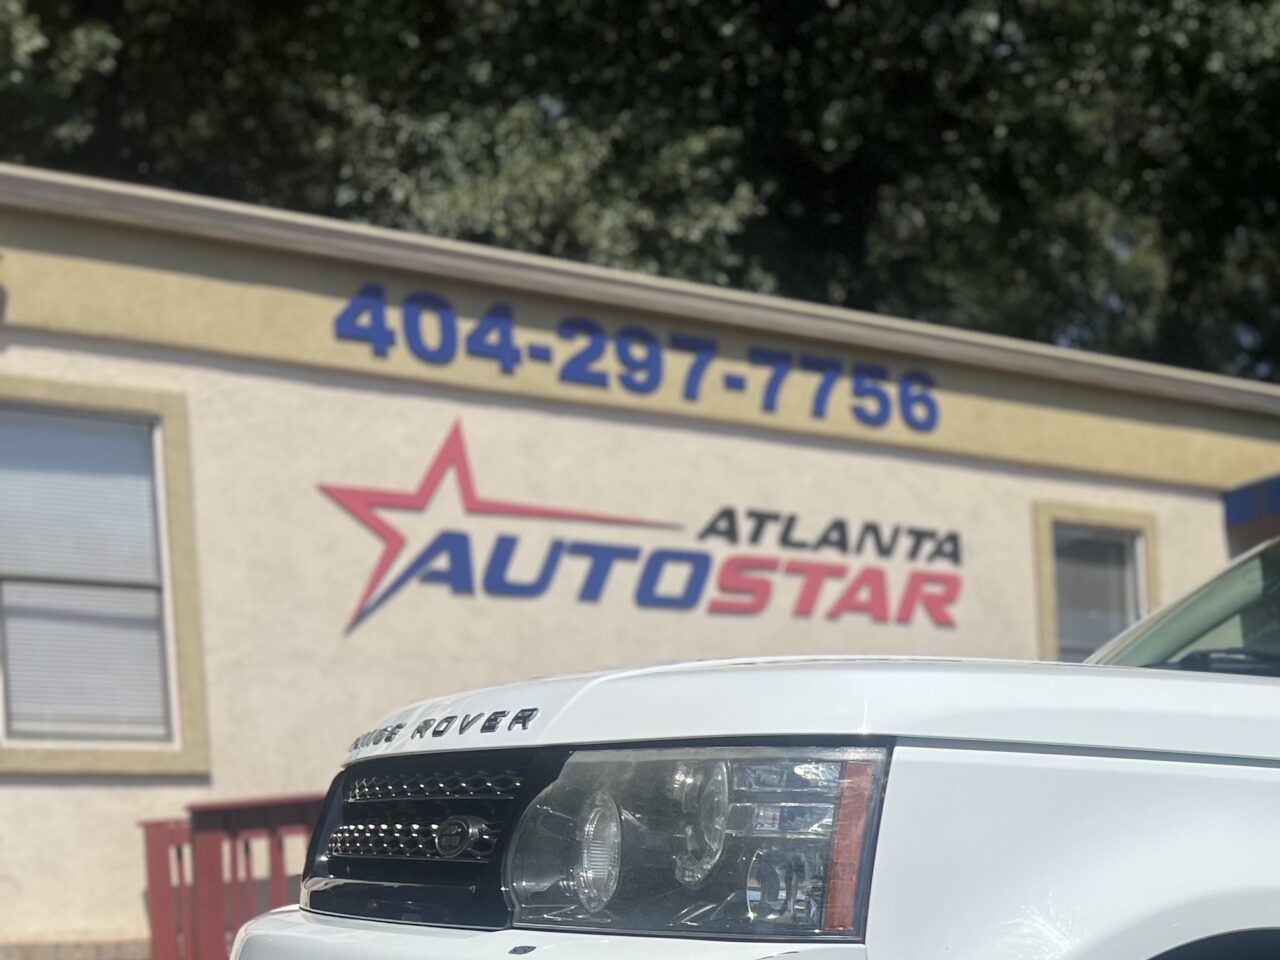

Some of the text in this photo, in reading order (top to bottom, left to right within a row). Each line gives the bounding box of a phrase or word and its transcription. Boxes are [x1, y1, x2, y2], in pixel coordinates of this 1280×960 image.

[333, 284, 942, 433] 404-297-7756
[697, 507, 964, 565] ATLANTA
[410, 707, 540, 740] ROVER
